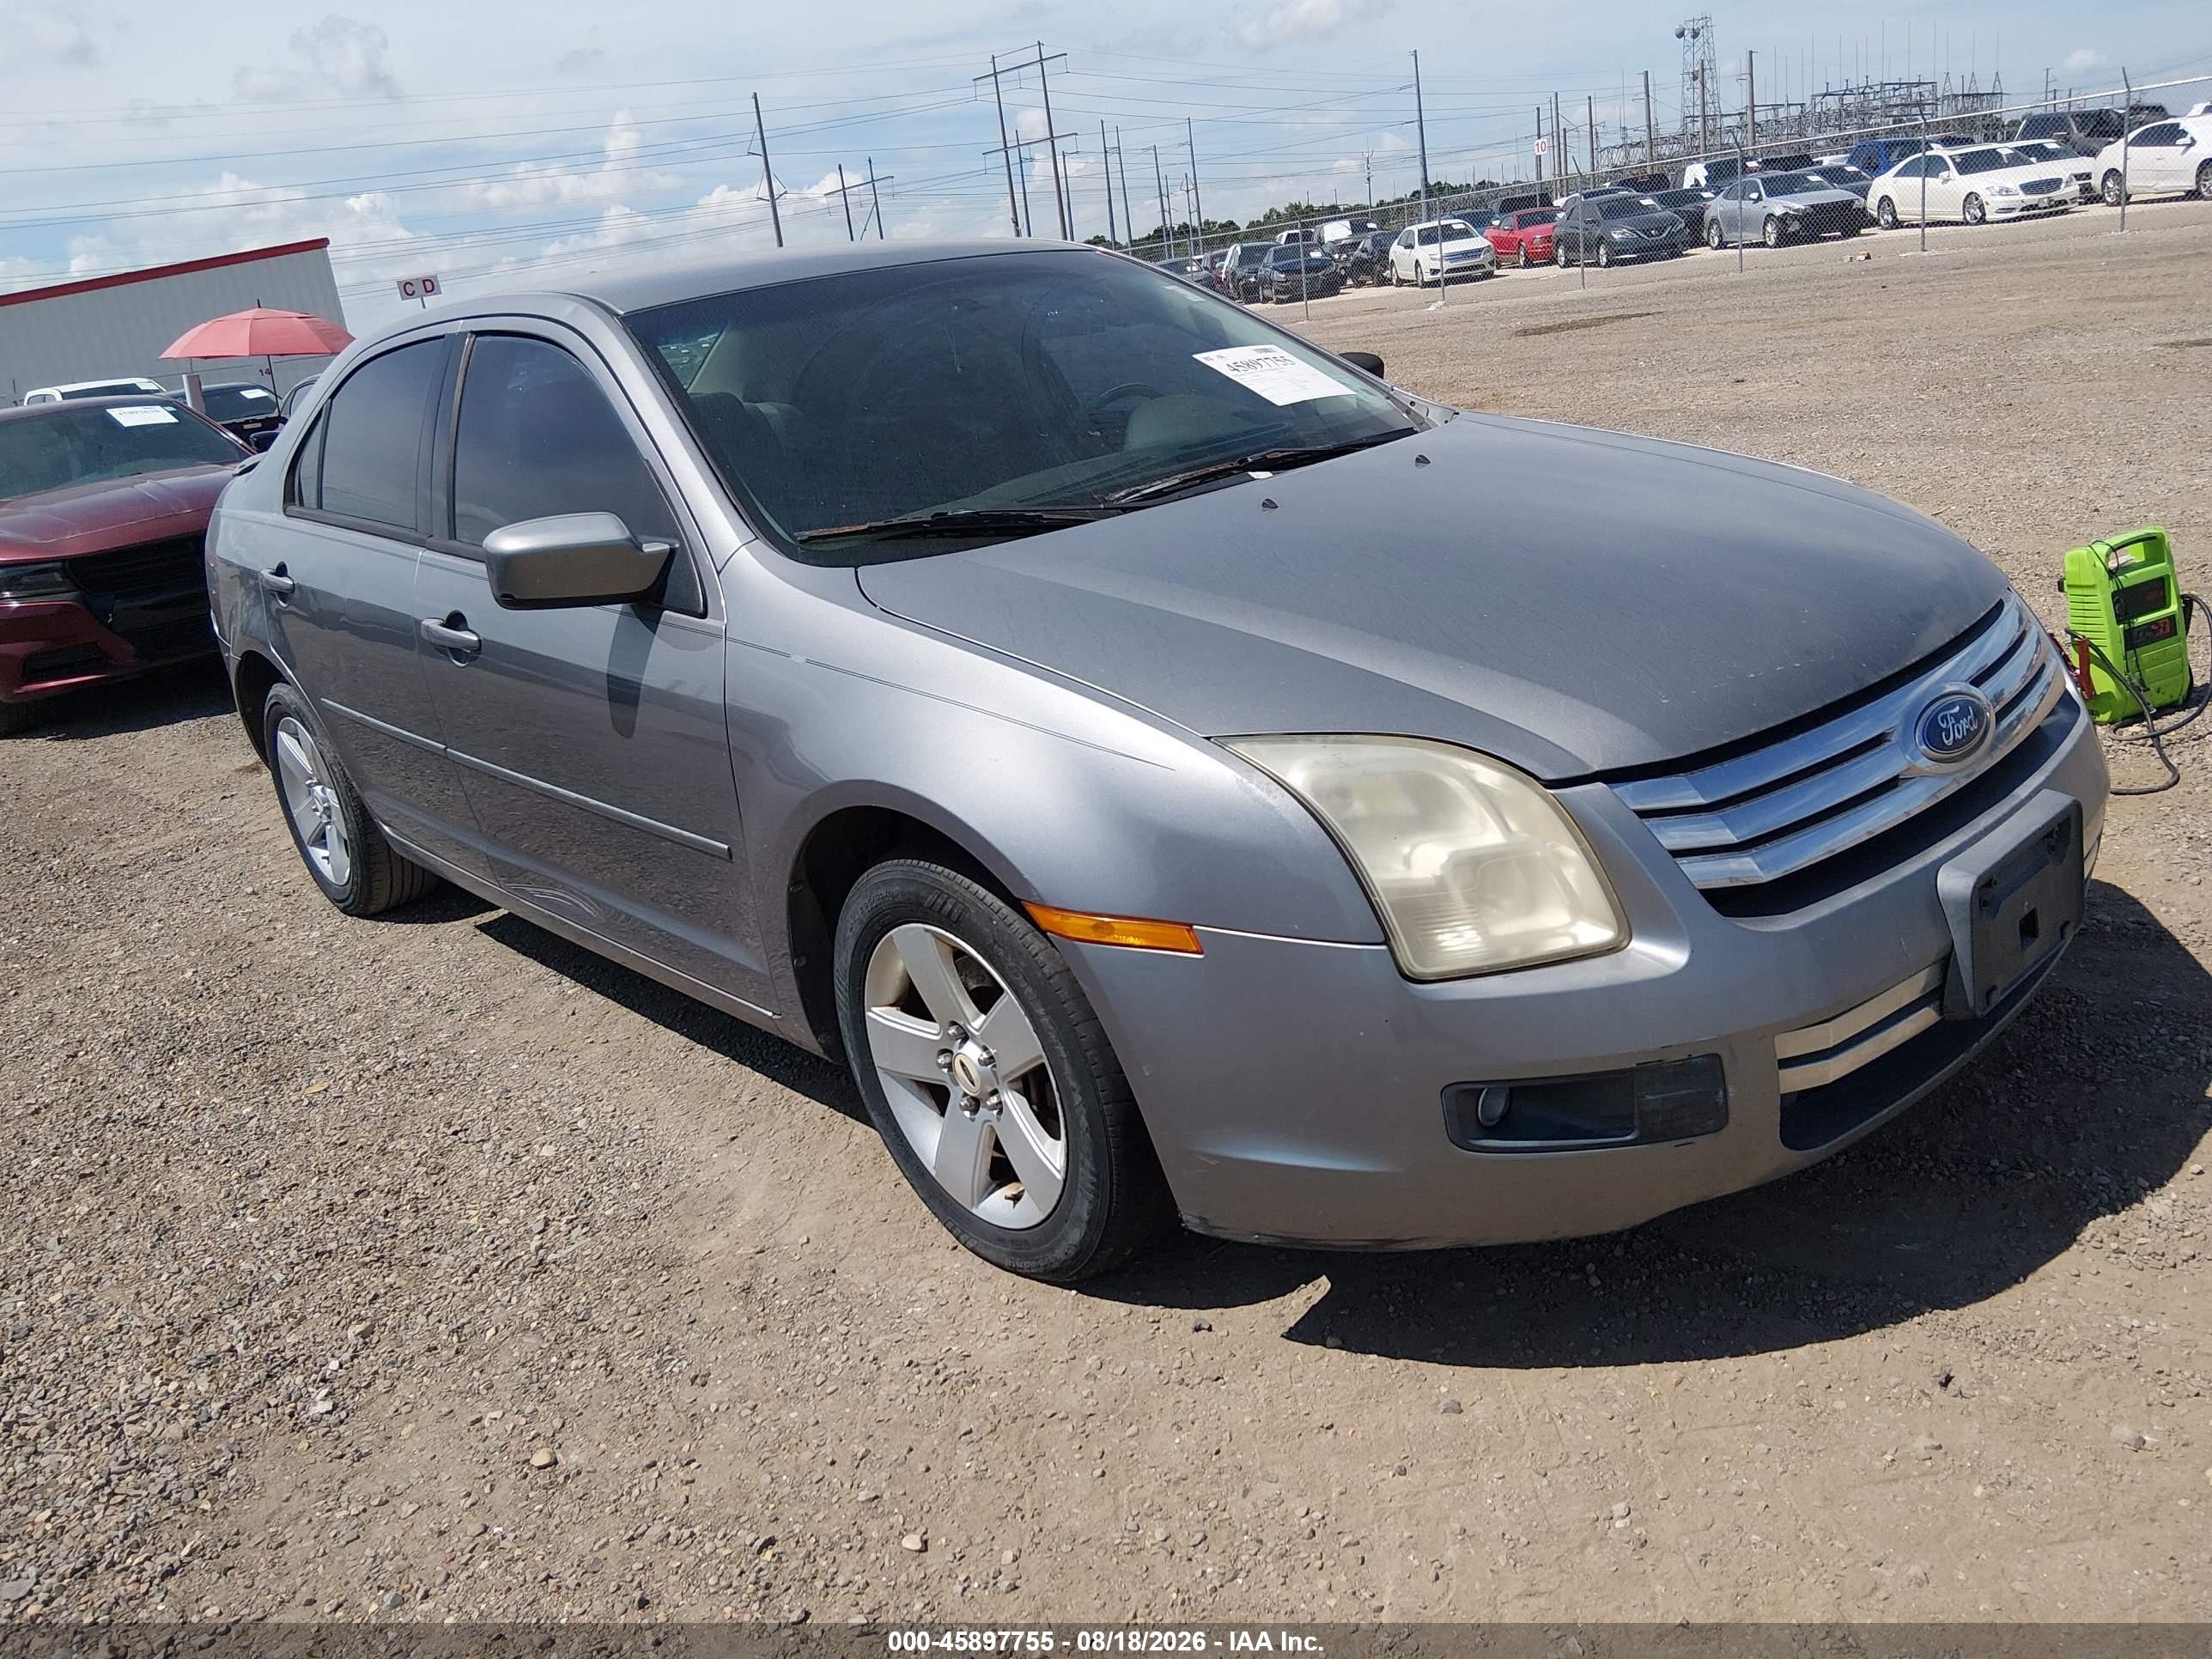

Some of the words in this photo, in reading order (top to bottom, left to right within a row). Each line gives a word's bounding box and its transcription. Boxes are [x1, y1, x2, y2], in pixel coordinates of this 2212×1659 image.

[1534, 140, 1547, 153] 10
[403, 281, 416, 296] C
[422, 278, 435, 294] D
[1225, 356, 1297, 373] 45897755
[1937, 704, 1978, 746] Ford
